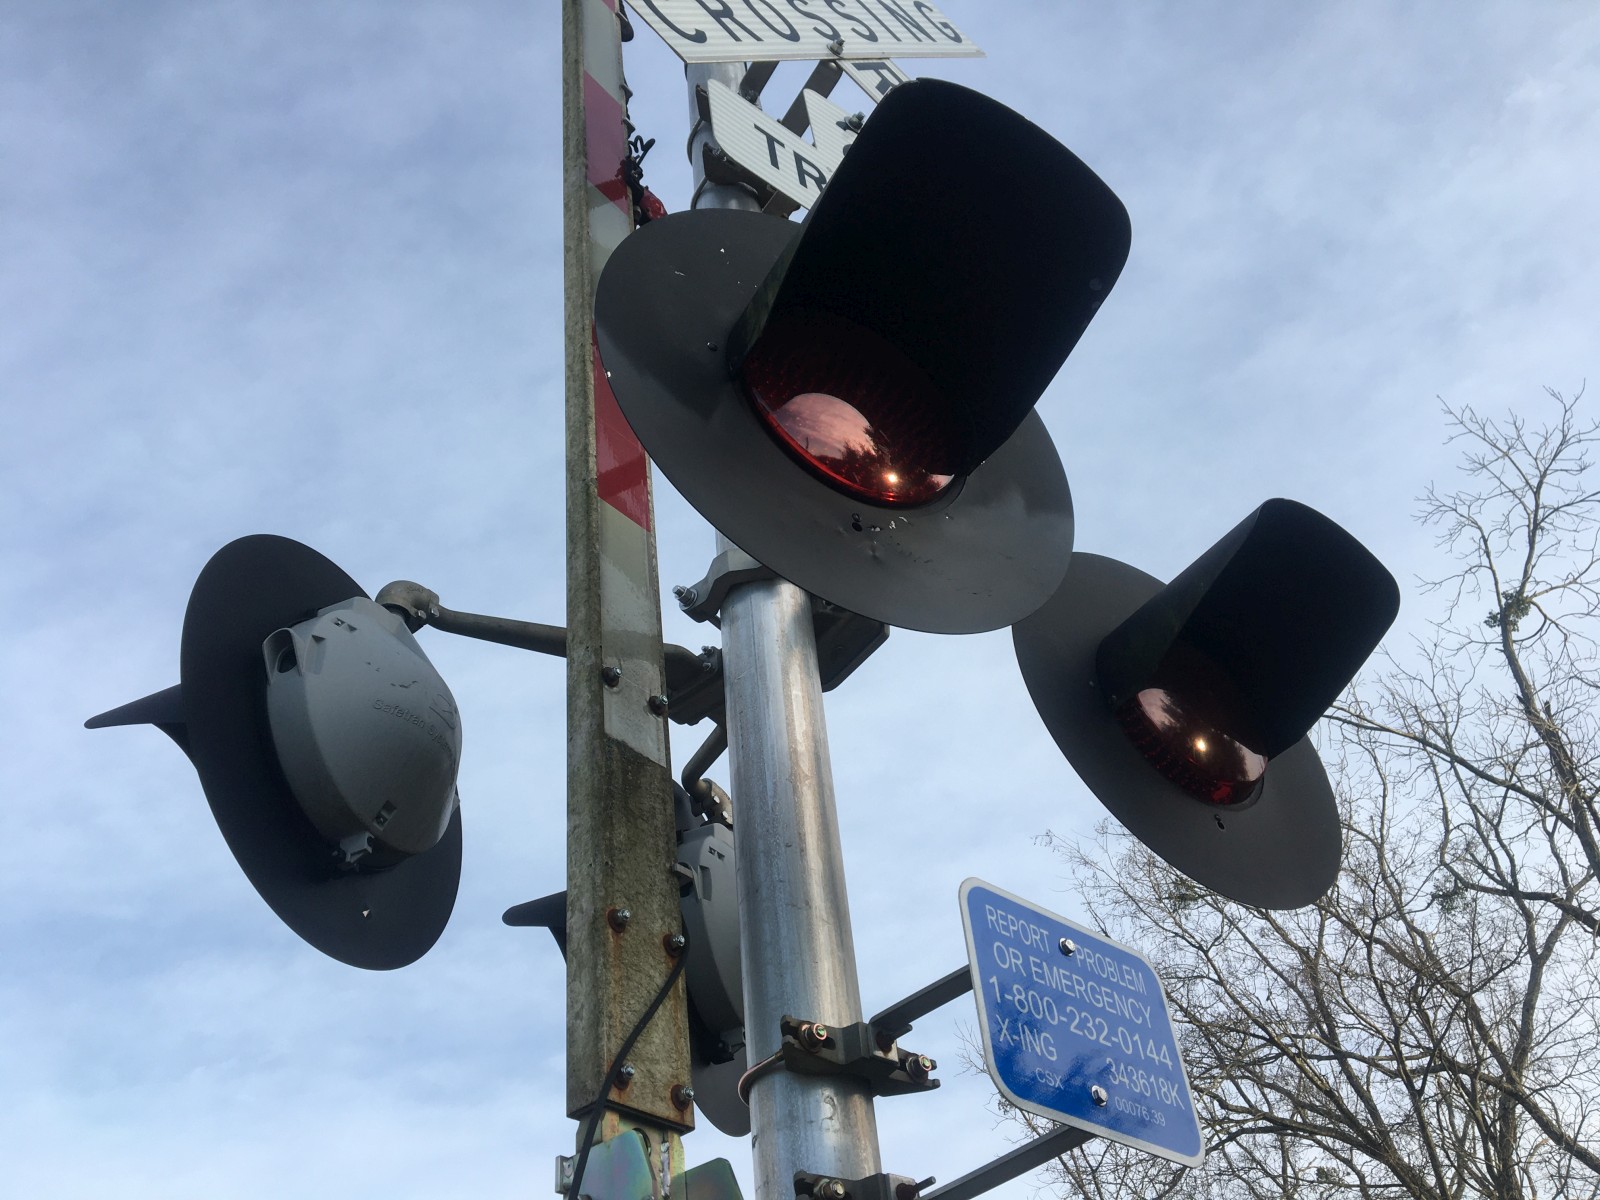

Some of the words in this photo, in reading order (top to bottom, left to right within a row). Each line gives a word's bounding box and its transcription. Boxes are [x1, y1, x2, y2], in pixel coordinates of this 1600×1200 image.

[649, 0, 963, 44] CROSSING
[373, 700, 425, 729] Safetran
[985, 905, 1049, 953] REPORT
[1075, 945, 1146, 994] PROBLEM
[994, 942, 1025, 976] OR
[1030, 957, 1151, 1028] EMERGENCY
[990, 976, 1172, 1069] 1-800-232-0144
[996, 1014, 1057, 1061] X-ING
[1106, 1057, 1184, 1109] 343618K
[1036, 1068, 1064, 1090] CSX
[1115, 1096, 1166, 1127] 00076.39
